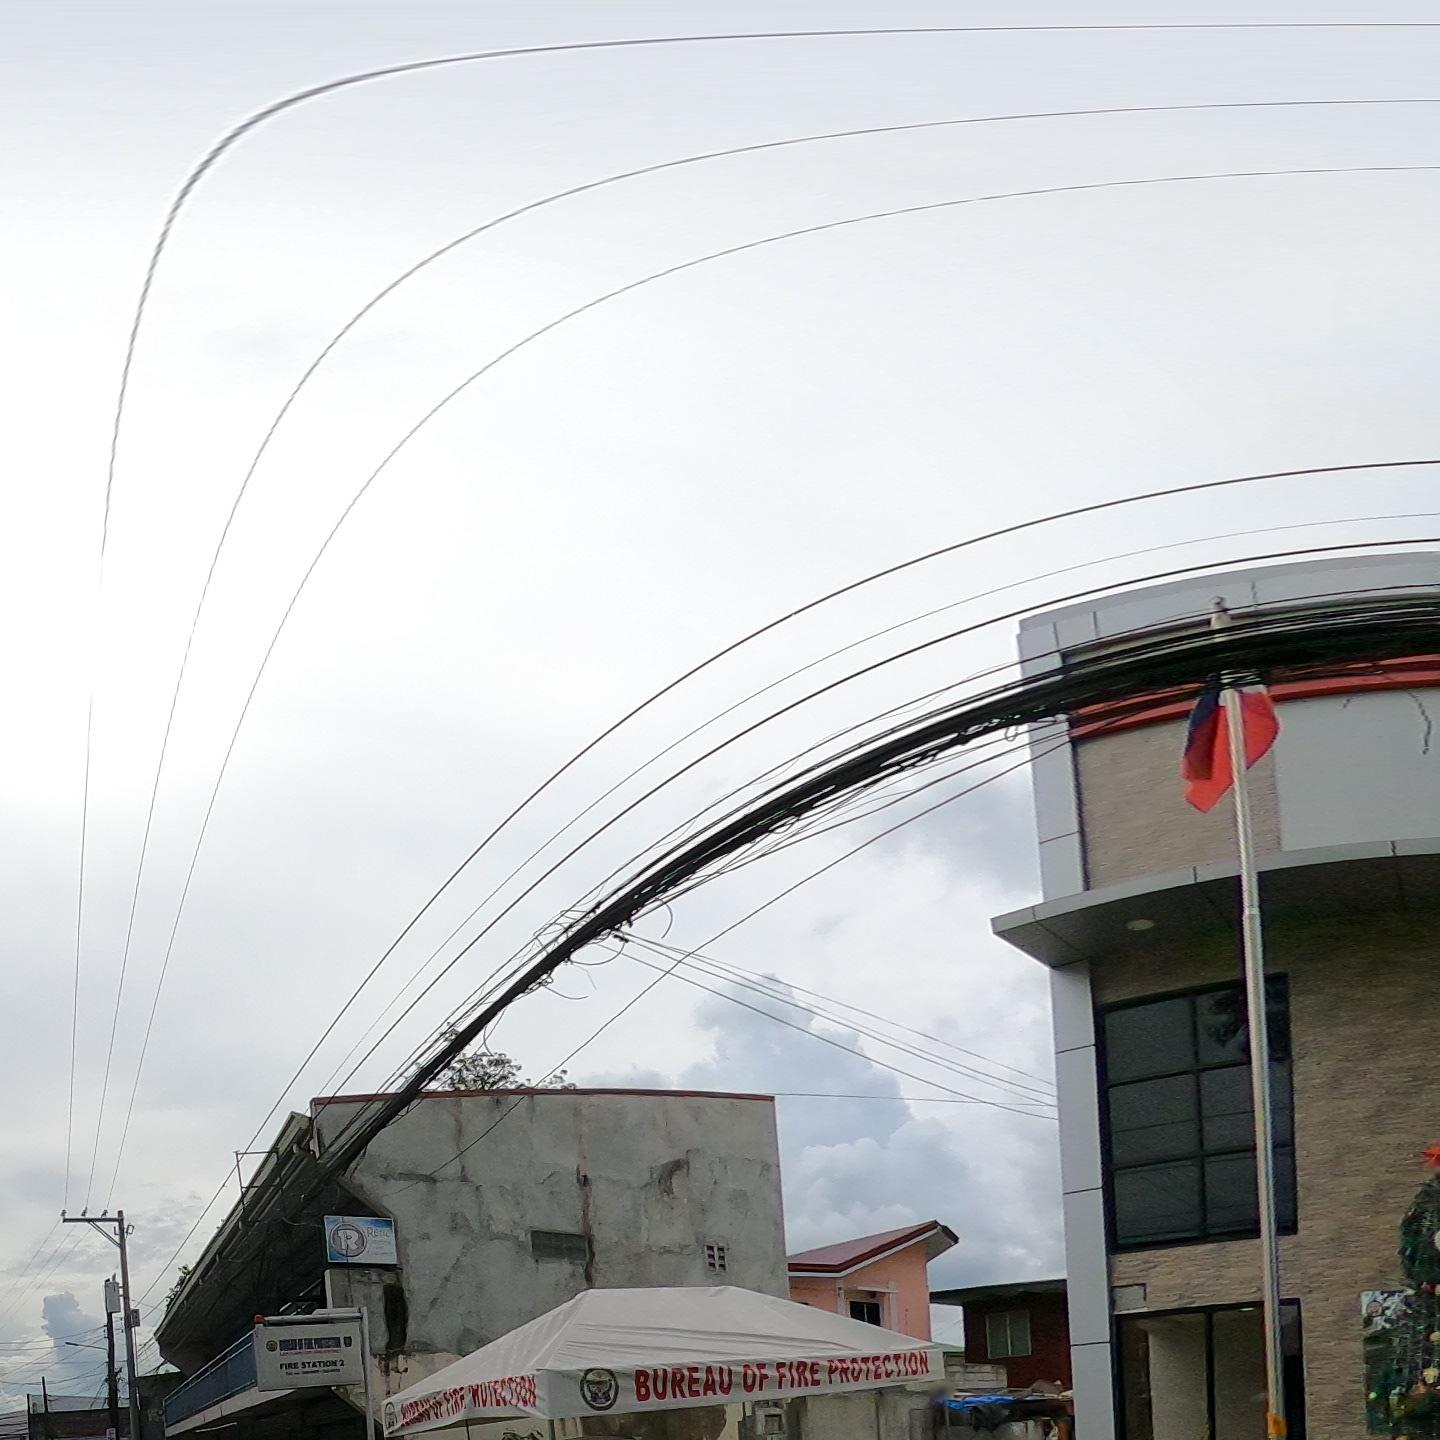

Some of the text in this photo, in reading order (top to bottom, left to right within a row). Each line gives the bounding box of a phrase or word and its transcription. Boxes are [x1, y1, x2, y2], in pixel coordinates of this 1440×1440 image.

[280, 1362, 299, 1370] FIRE
[301, 1360, 338, 1369] STATION
[634, 1350, 931, 1402] BUREAU OF FIRE PROTECTION
